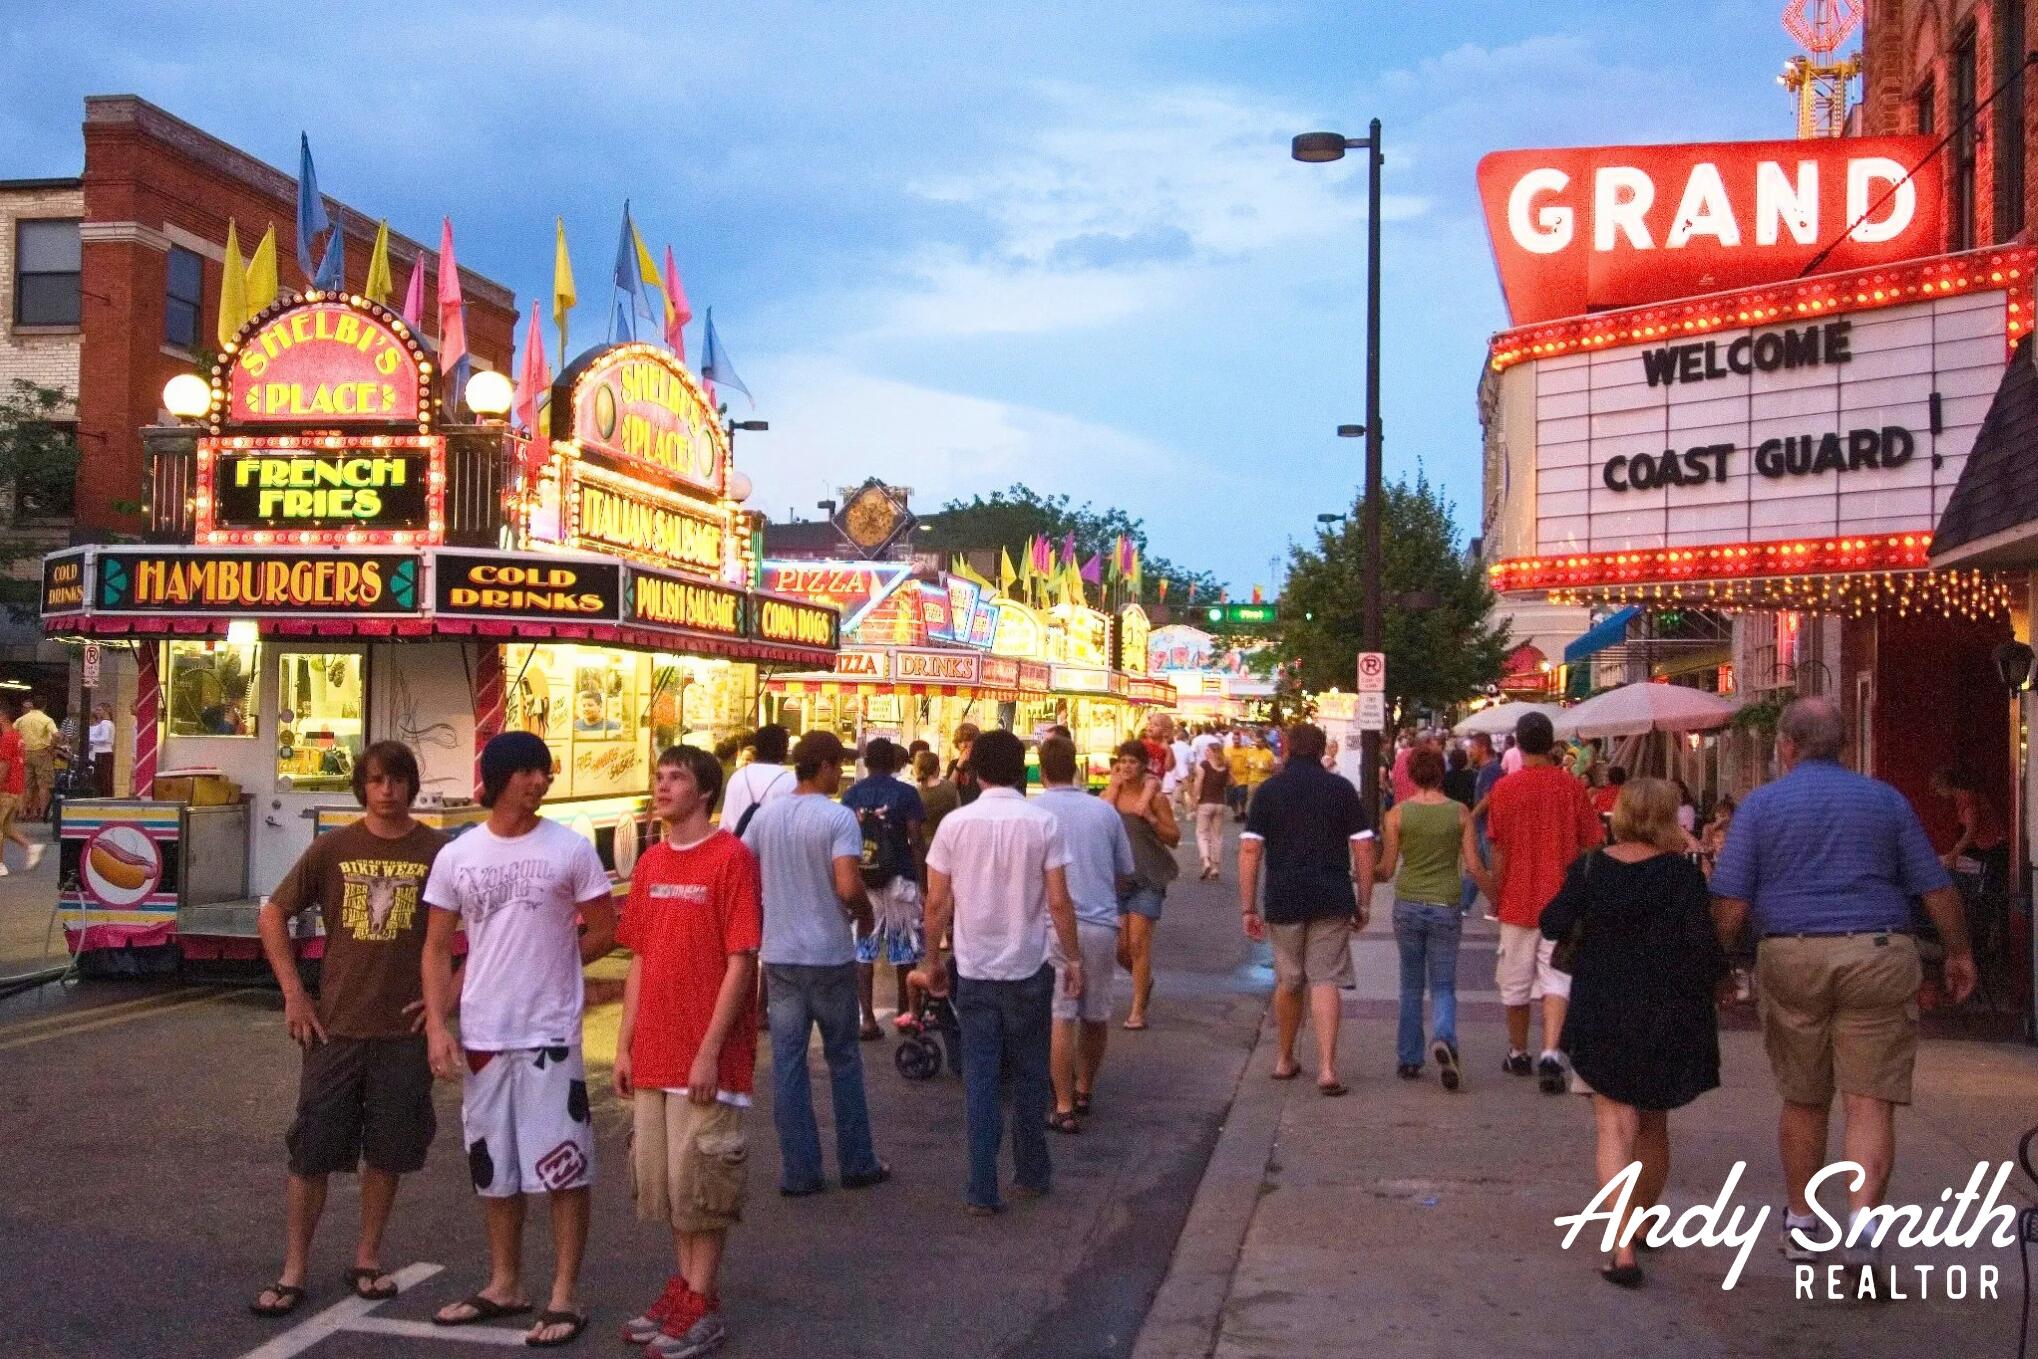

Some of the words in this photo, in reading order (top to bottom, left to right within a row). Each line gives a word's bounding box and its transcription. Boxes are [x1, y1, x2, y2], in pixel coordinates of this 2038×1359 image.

[1508, 157, 1917, 254] GRAND
[241, 310, 402, 378] SHELBI'S
[1642, 320, 1853, 388] WELCOME
[265, 382, 377, 415] PLACE
[630, 414, 690, 475] PLACE
[235, 458, 406, 488] FRENCH
[1603, 442, 1736, 493] COAST
[259, 489, 382, 519] FRIES
[580, 486, 654, 550] ITALIAN
[653, 510, 722, 568] SAUSAGE
[54, 563, 78, 582] COLD
[135, 559, 382, 606] HAMBURGERS
[468, 565, 577, 588] COLD
[775, 567, 866, 594] PIZZA
[49, 584, 84, 604] DRINKS
[451, 588, 604, 613] DRINKS
[637, 576, 686, 623] POLISH
[686, 586, 737, 633] SAUSAGE
[761, 601, 797, 640] CORN
[798, 607, 830, 646] DOGS
[836, 654, 877, 675] IZZA
[901, 654, 974, 680] DRINKS
[339, 861, 379, 877] BIKE
[383, 863, 428, 878] WEEK
